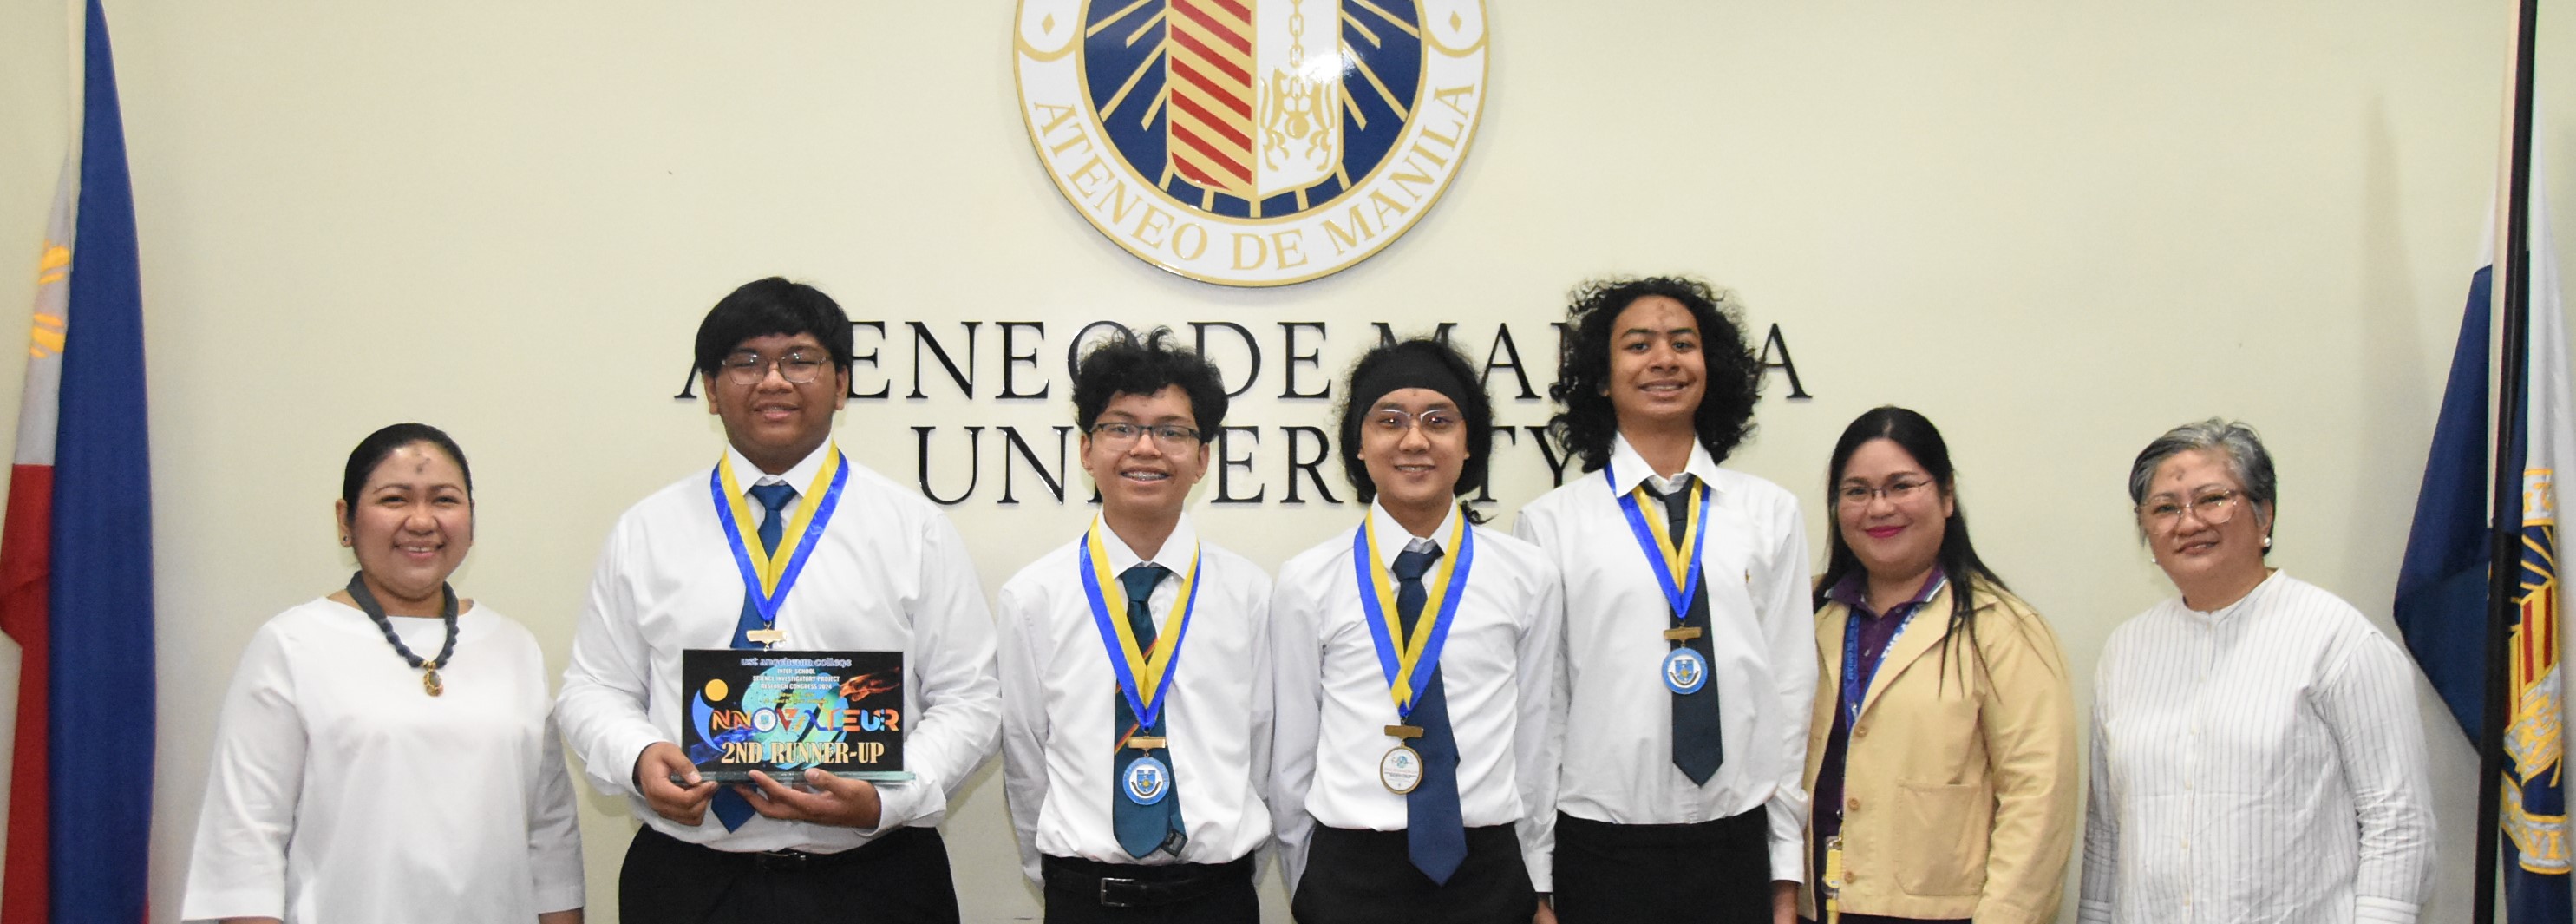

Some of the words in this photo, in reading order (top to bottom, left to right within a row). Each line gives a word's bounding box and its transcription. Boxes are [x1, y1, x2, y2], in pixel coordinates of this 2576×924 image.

[1033, 102, 1209, 262] ATENEO
[1229, 228, 1309, 272] DE
[1318, 82, 1475, 259] MANILA
[1187, 321, 1331, 399] DE
[721, 741, 763, 764] 2ND
[770, 741, 885, 764] RUNNER-UP
